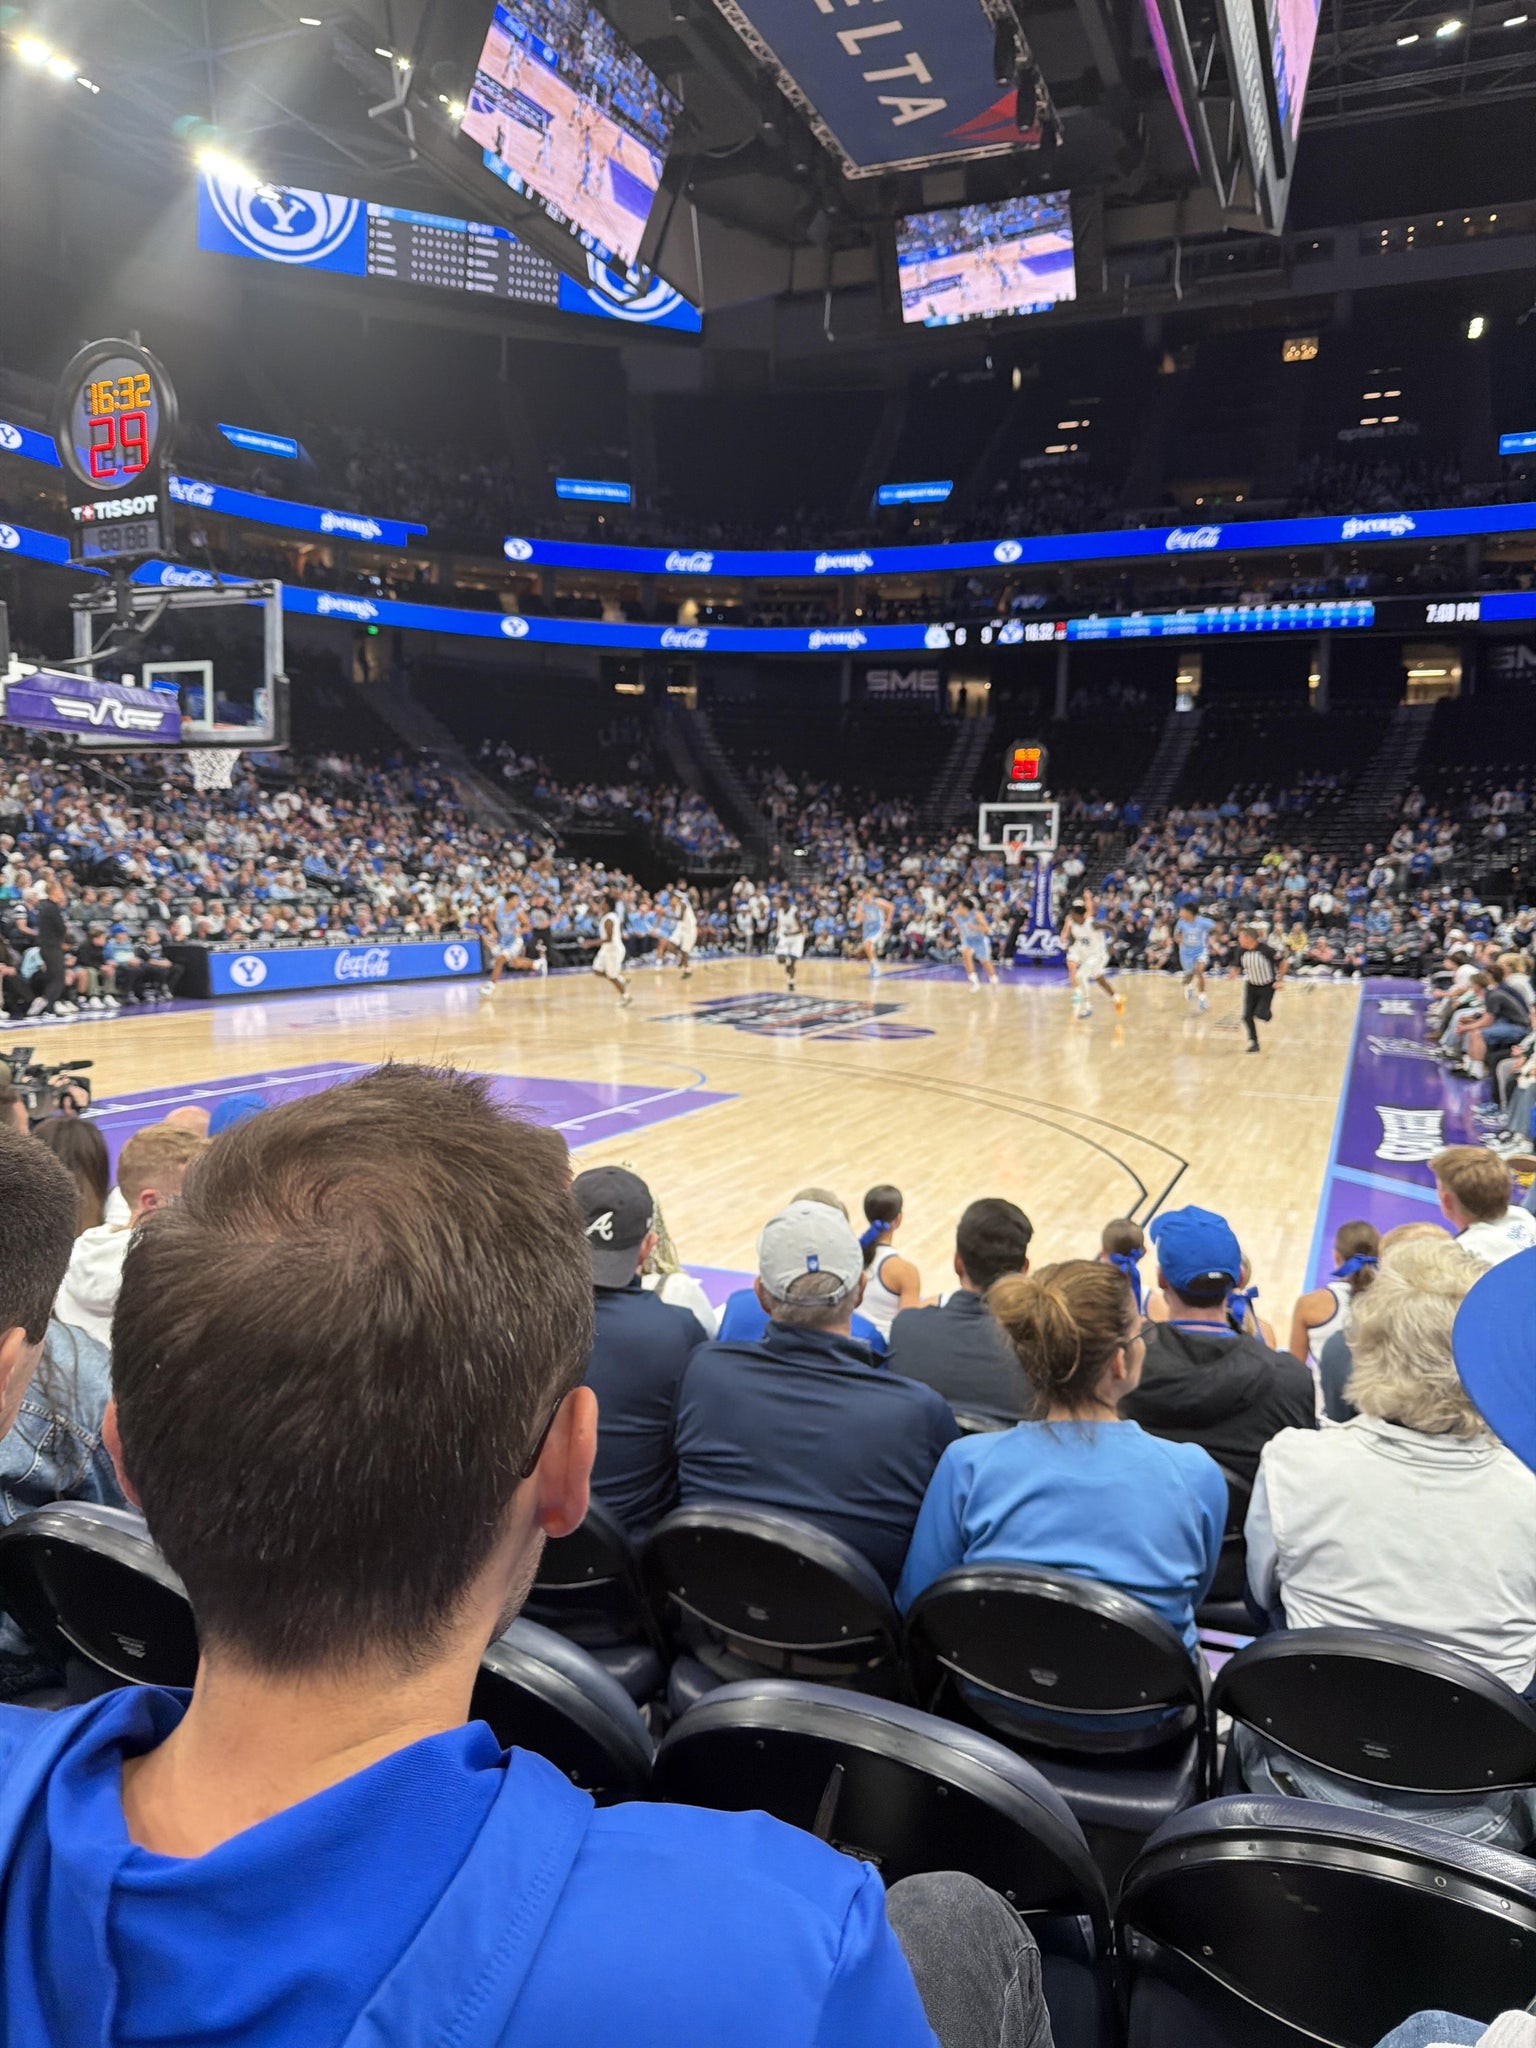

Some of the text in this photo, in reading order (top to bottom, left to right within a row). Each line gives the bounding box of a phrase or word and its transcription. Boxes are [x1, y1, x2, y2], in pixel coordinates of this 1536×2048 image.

[90, 373, 151, 416] 16:32
[88, 411, 150, 479] 29
[94, 495, 158, 520] TISSOT
[866, 669, 940, 691] SME
[335, 948, 391, 980] Coca-Cola
[583, 1211, 615, 1241] A
